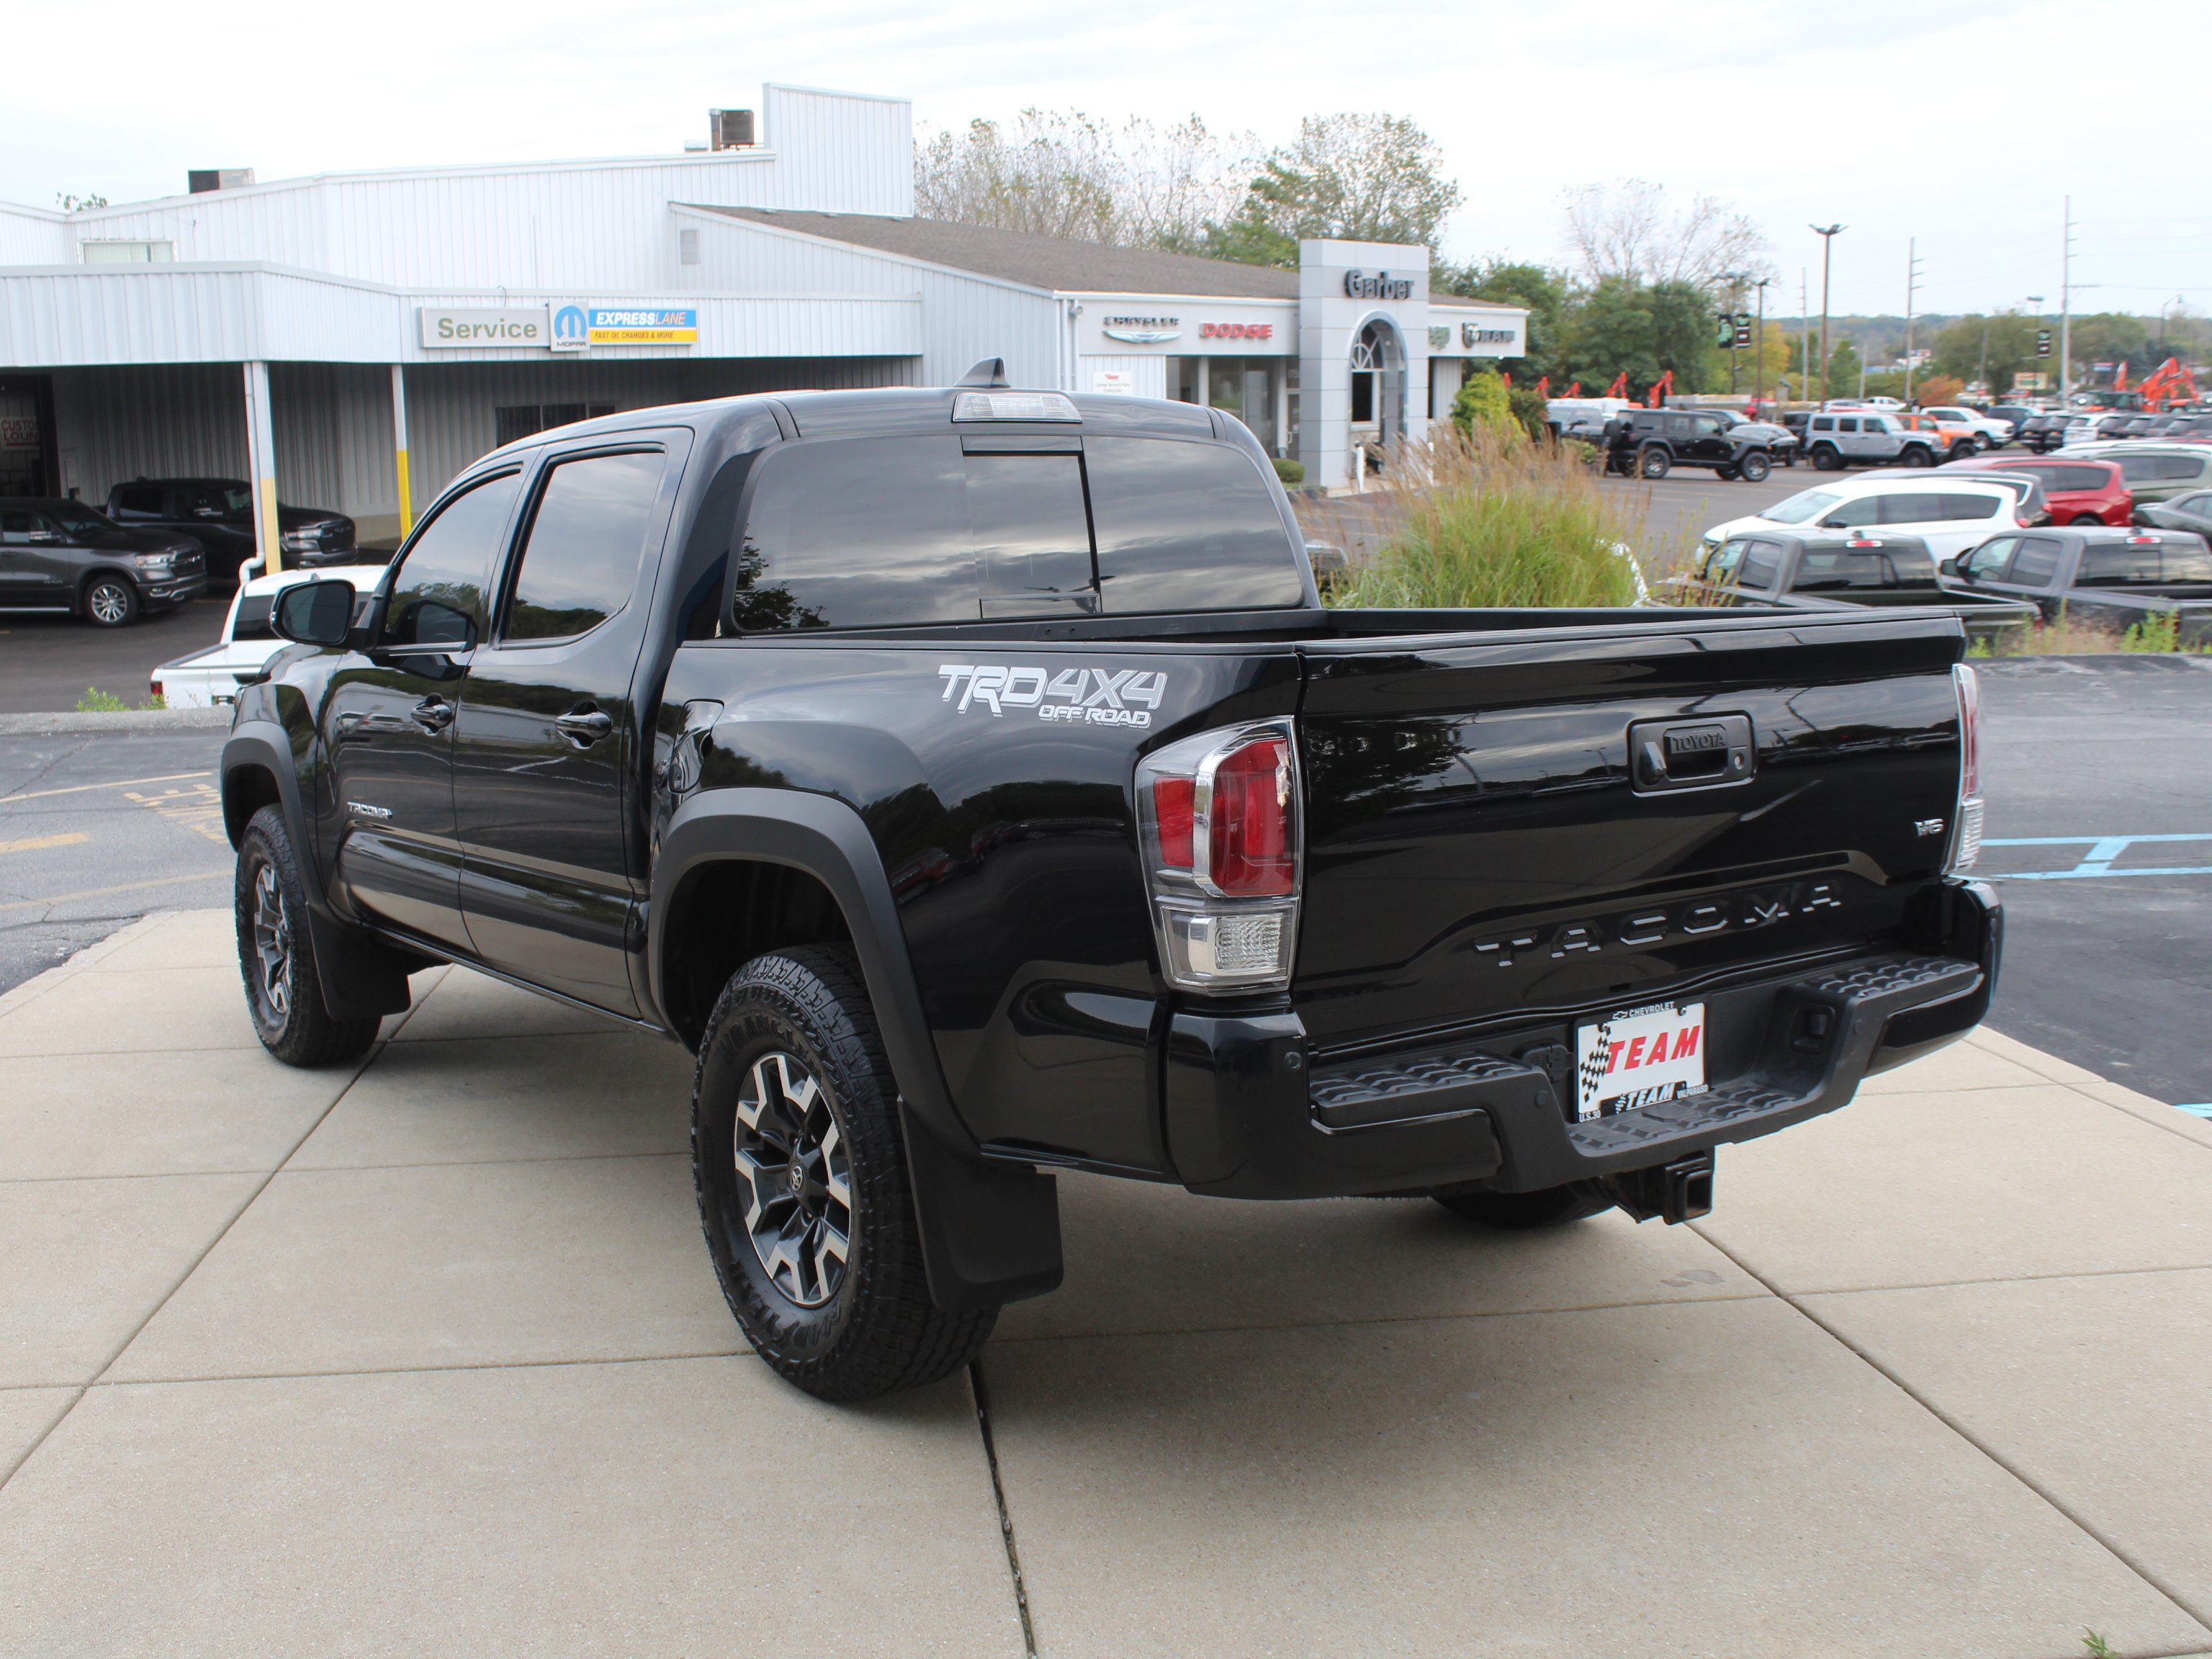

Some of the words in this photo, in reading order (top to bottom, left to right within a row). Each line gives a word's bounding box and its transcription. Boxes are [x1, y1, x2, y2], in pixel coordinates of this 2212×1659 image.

[1344, 269, 1415, 300] Garber
[438, 318, 538, 339] Service
[1103, 316, 1179, 326] CHRYSLER
[1200, 322, 1273, 338] DODGE
[938, 665, 1048, 717] TRD
[1038, 704, 1084, 723] OFF
[1085, 708, 1152, 729] ROAD
[1673, 732, 1726, 751] TOYOTA
[347, 801, 390, 819] TACOMA
[1474, 879, 1843, 967] TACOMA
[1628, 1001, 1675, 1017] CHEVROLET
[1605, 1025, 1701, 1074] TEAM
[1626, 1082, 1675, 1109] TEAM
[1676, 1084, 1709, 1100] VALPARAISO
